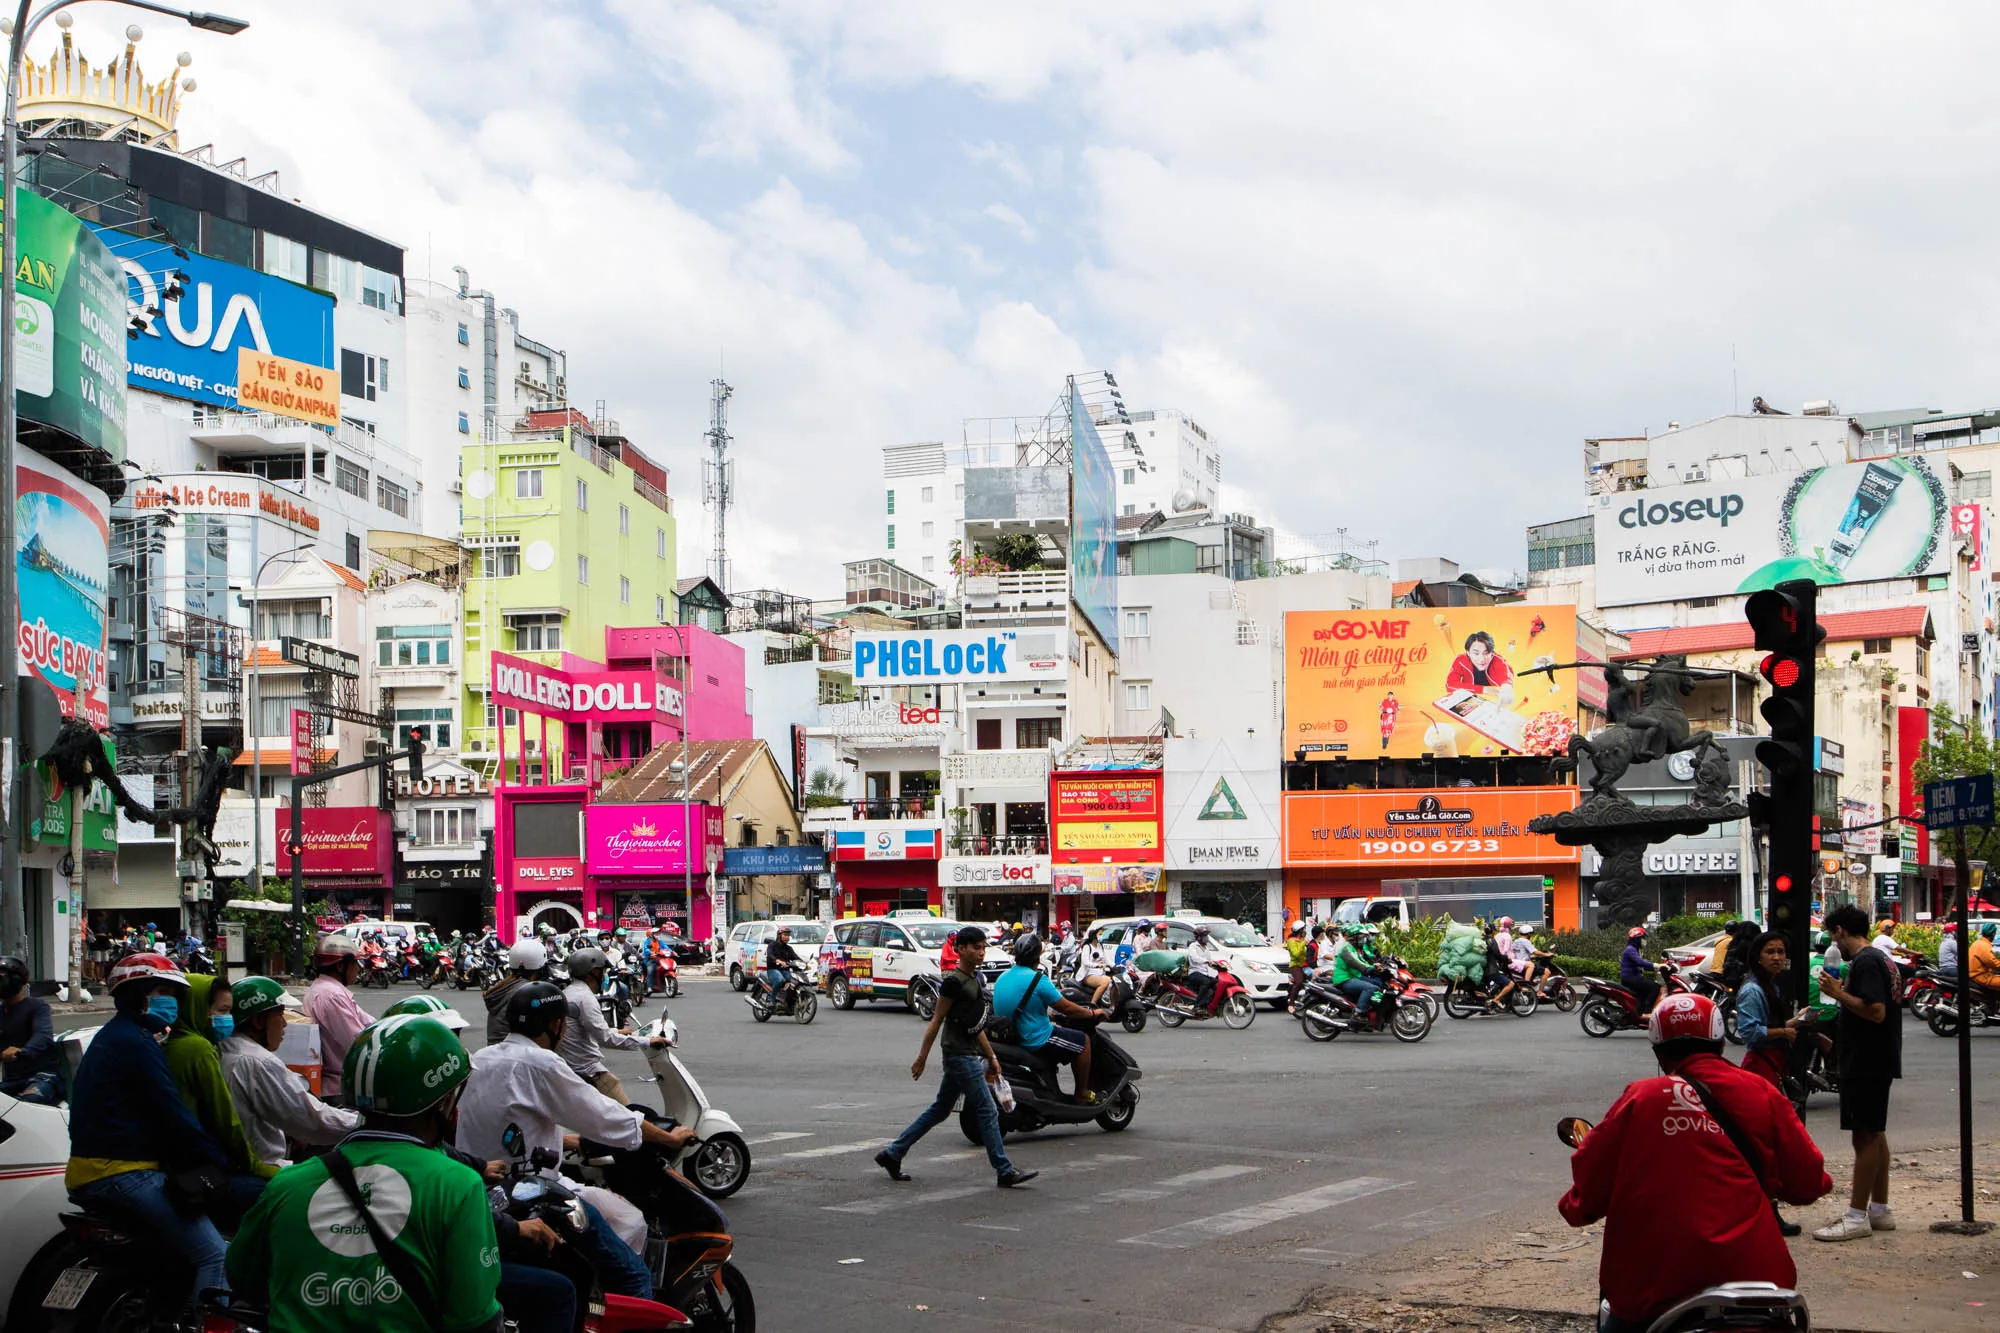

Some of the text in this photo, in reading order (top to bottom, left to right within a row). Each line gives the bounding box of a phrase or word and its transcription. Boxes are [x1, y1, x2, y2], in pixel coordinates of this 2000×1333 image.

[15, 253, 56, 294] AN
[134, 365, 175, 384] NGƯỜI
[177, 373, 203, 390] VIỆT
[257, 356, 324, 391] YẾN SÀO
[80, 375, 97, 406] VÀ
[271, 387, 295, 408] GIỜ
[296, 395, 338, 419] ANPHA
[135, 485, 251, 509] Coffee & Ice Cream
[259, 489, 320, 532] Coffee & Ice Cream
[1618, 494, 1744, 529] closeup
[1618, 540, 1721, 563] TRẮNG RĂNG.
[1645, 554, 1745, 576] vị dừa thơm mát
[1332, 620, 1410, 641] GO-VIET
[21, 617, 61, 670] SỨC
[63, 640, 93, 689] BAY,
[292, 642, 309, 662] THẾ
[855, 637, 1007, 678] PHGLock
[1300, 642, 1428, 676] Món gì cũng có
[497, 664, 683, 717] DOLL EYES DOLL EYES
[1356, 678, 1376, 694] giao
[1378, 671, 1406, 687] nhanh
[832, 703, 940, 726] Sharetea
[298, 761, 310, 773] HOA
[397, 774, 489, 796] HOTEL
[1098, 782, 1114, 790] CHIM
[1968, 783, 1977, 803] 7
[1108, 802, 1131, 810] 6733
[279, 819, 374, 857] Tgioinuochoa
[1312, 827, 1330, 839] TƯ
[1334, 824, 1361, 839] VẤN
[1404, 826, 1441, 839] CHIM
[1482, 821, 1520, 837] MIỄN
[605, 830, 683, 858] Thegioinuochoa
[1189, 846, 1259, 863] LEMAN JEWELS
[1360, 839, 1499, 854] 1900 6733
[743, 851, 800, 865] KHU PHỐ 4
[1649, 853, 1737, 872] COFFEE
[449, 864, 481, 878] TÍN
[520, 867, 574, 877] DOLL EYES
[953, 863, 1033, 881] Sharetea
[238, 992, 268, 1010] Grab
[1670, 1012, 1703, 1025] goviet
[423, 1052, 461, 1088] Grab
[1662, 1115, 1725, 1136] govie
[300, 1265, 403, 1307] Grab
